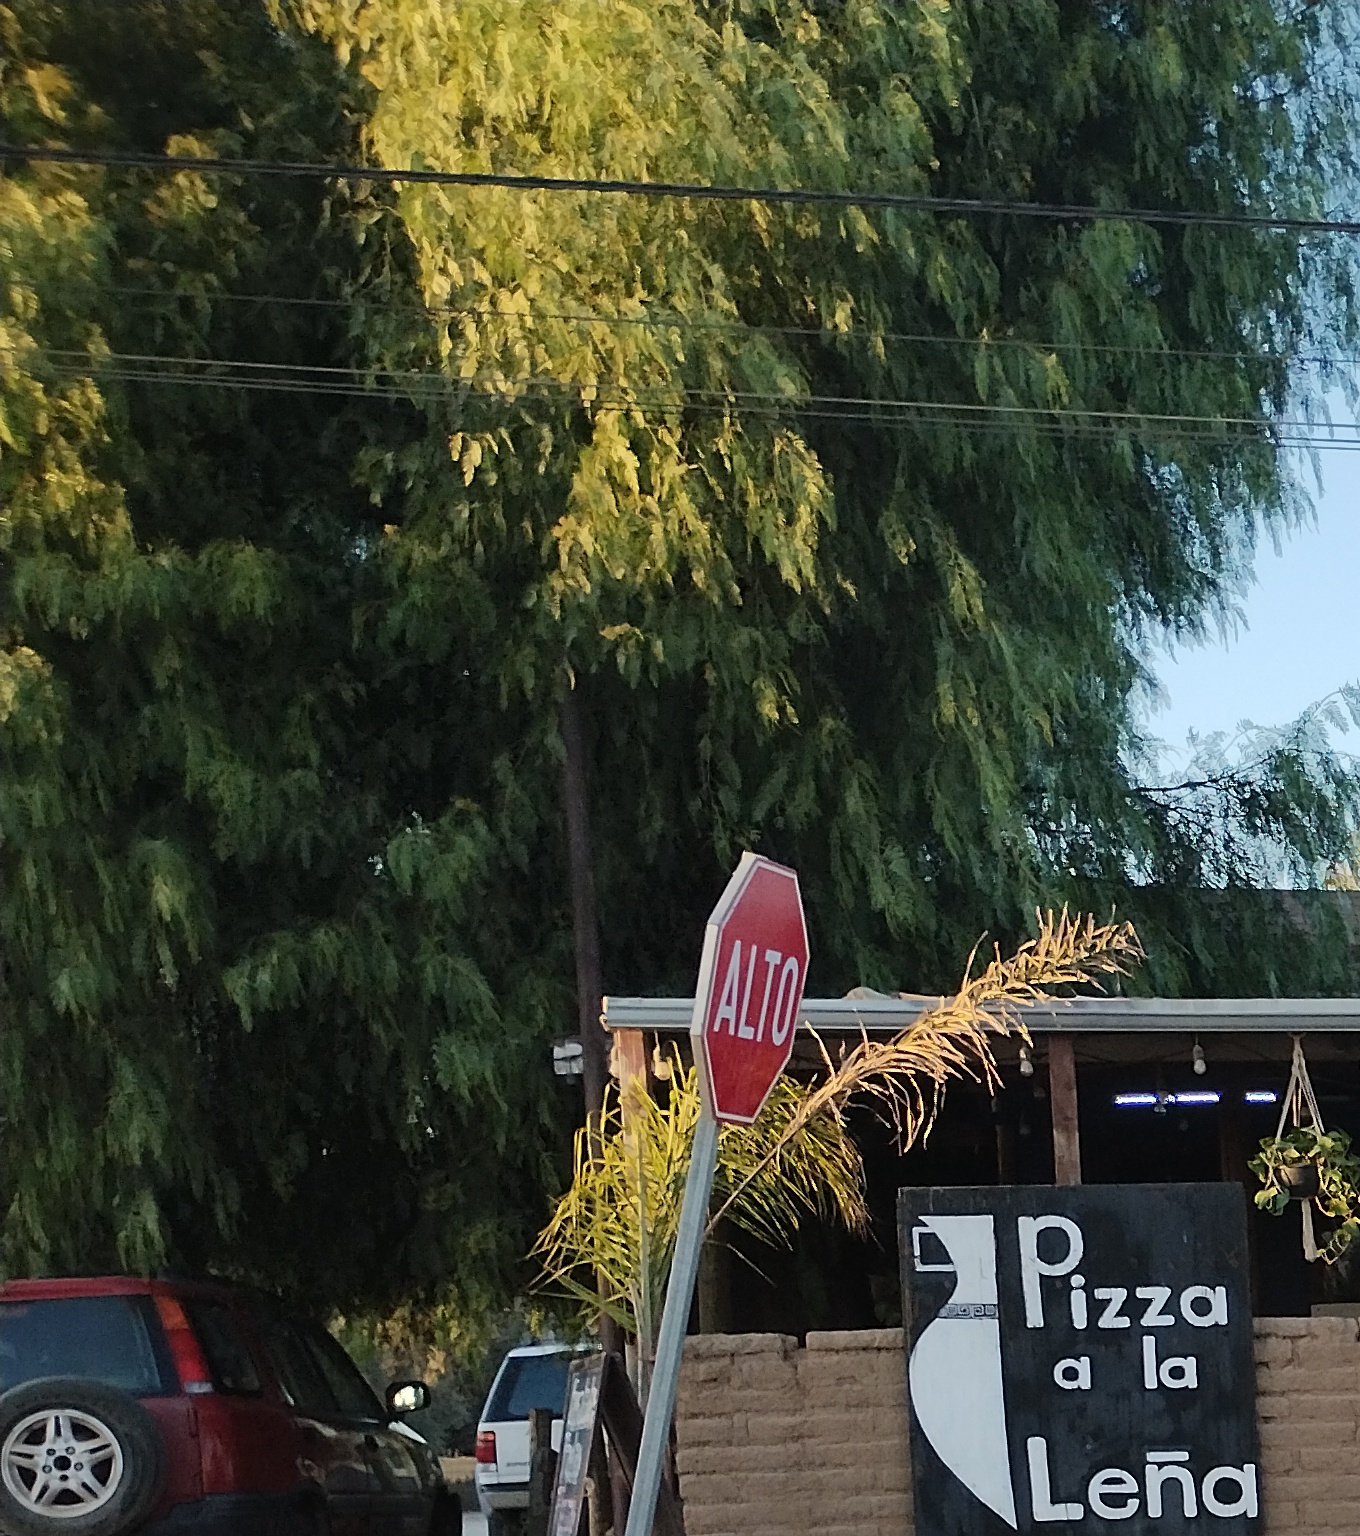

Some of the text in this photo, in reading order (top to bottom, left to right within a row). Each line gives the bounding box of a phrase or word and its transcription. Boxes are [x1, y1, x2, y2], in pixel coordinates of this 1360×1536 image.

[713, 939, 799, 1047] ALTO
[1017, 1214, 1229, 1330] Pizza
[1053, 1334, 1198, 1390] a la
[1026, 1435, 1259, 1521] Leña
